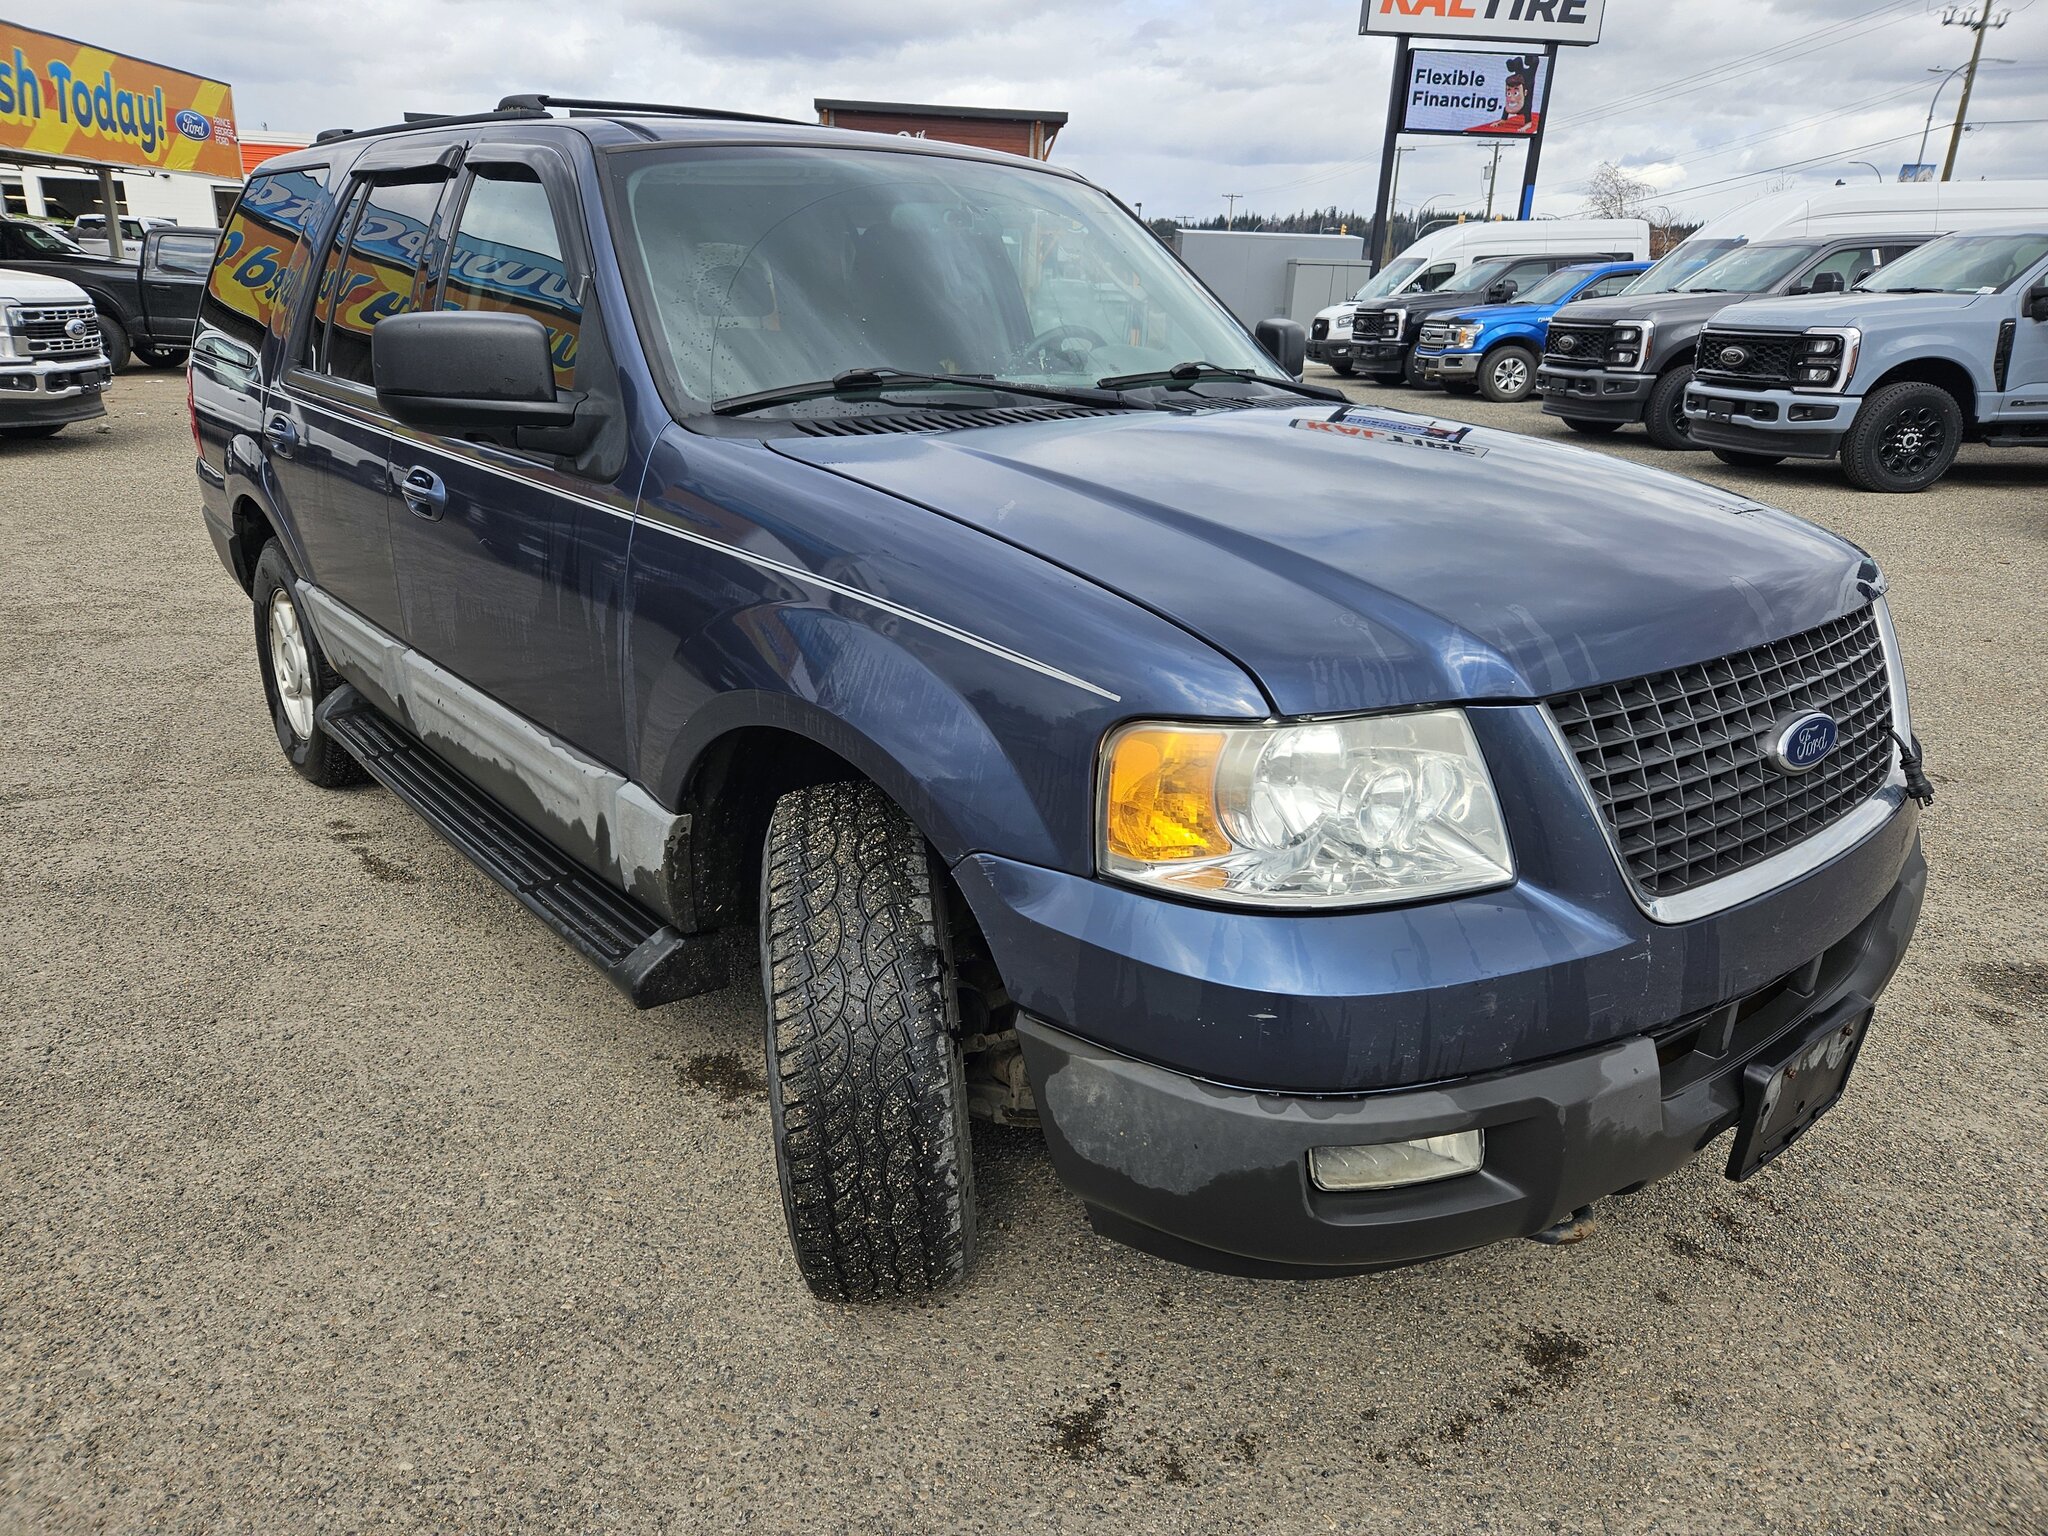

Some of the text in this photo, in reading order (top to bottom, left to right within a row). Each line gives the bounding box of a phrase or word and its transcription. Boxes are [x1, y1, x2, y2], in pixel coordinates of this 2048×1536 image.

[1414, 68, 1486, 87] Flexible
[47, 59, 167, 155] Today!
[1411, 91, 1503, 112] Financing.
[182, 113, 205, 137] Ford
[215, 135, 230, 146] FORD
[1796, 724, 1829, 761] Ford
